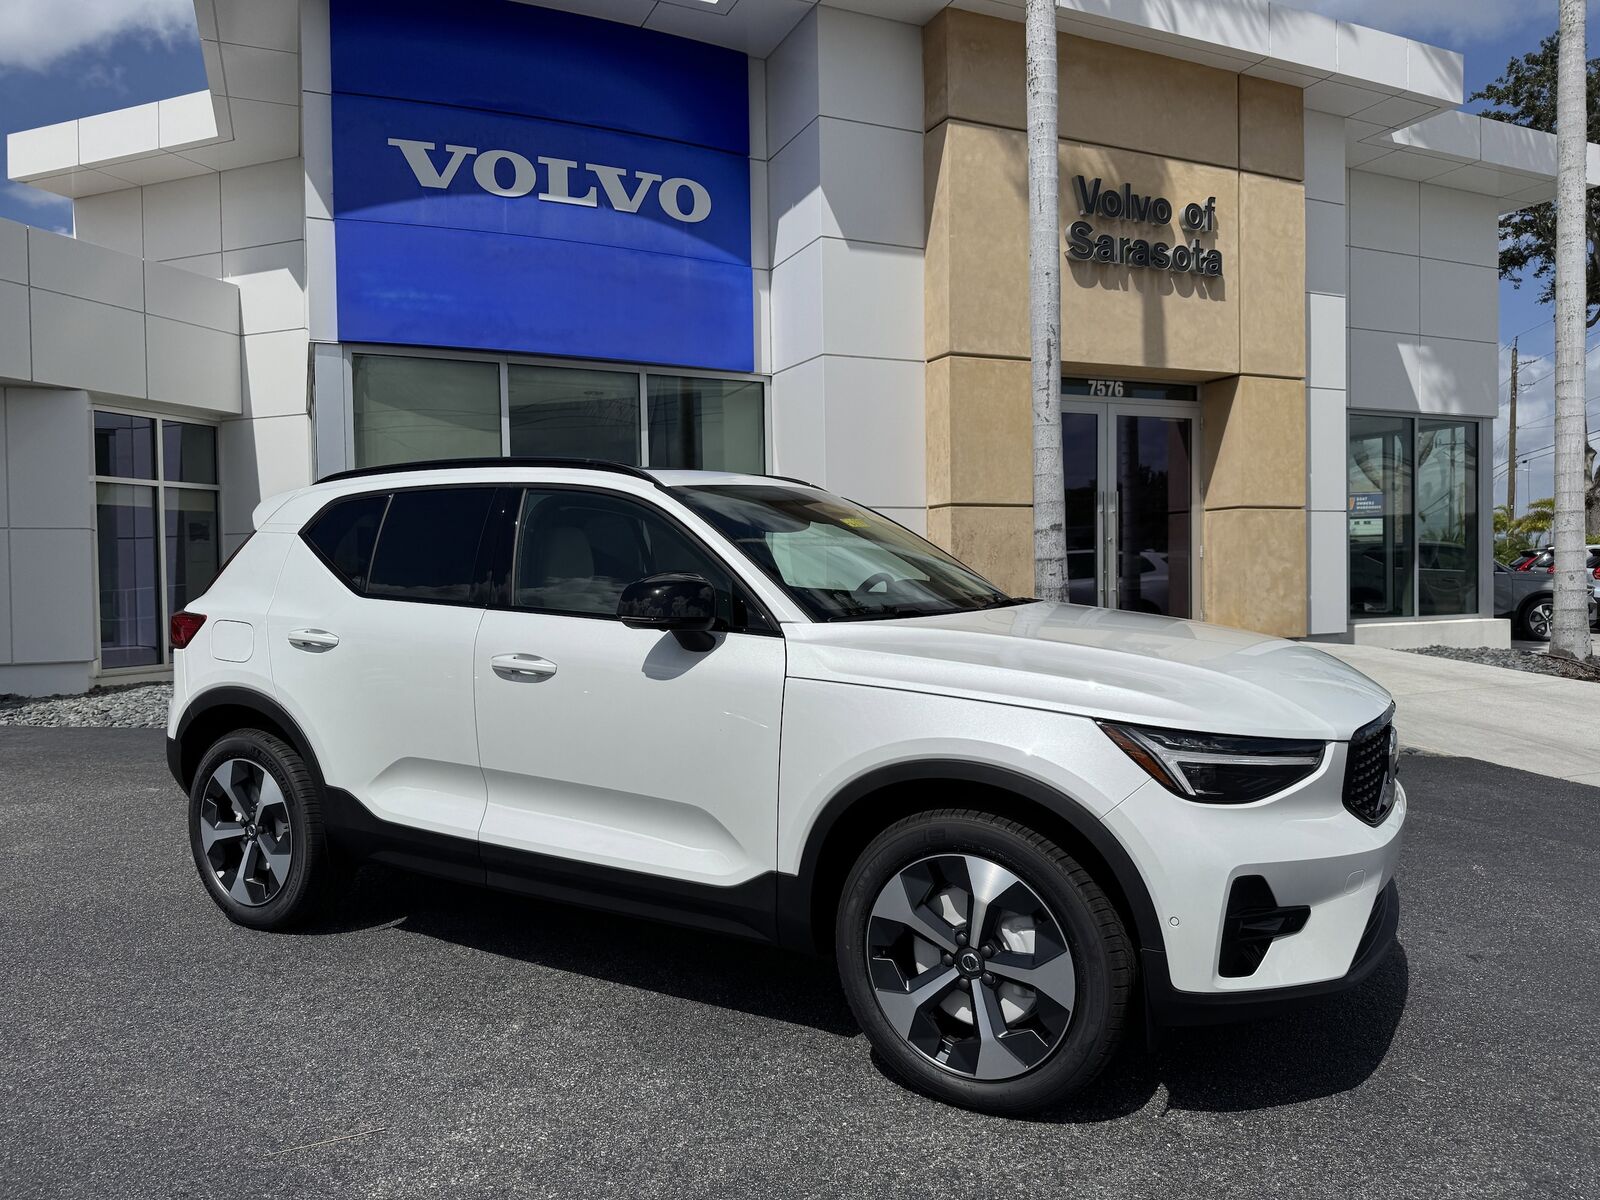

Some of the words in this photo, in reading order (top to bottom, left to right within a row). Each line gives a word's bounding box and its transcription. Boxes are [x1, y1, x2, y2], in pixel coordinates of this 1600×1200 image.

[388, 138, 712, 223] VOLVO
[1072, 175, 1173, 225] Volvo
[1179, 197, 1216, 232] of
[1064, 221, 1223, 277] Sarasota
[1087, 380, 1124, 397] 7576
